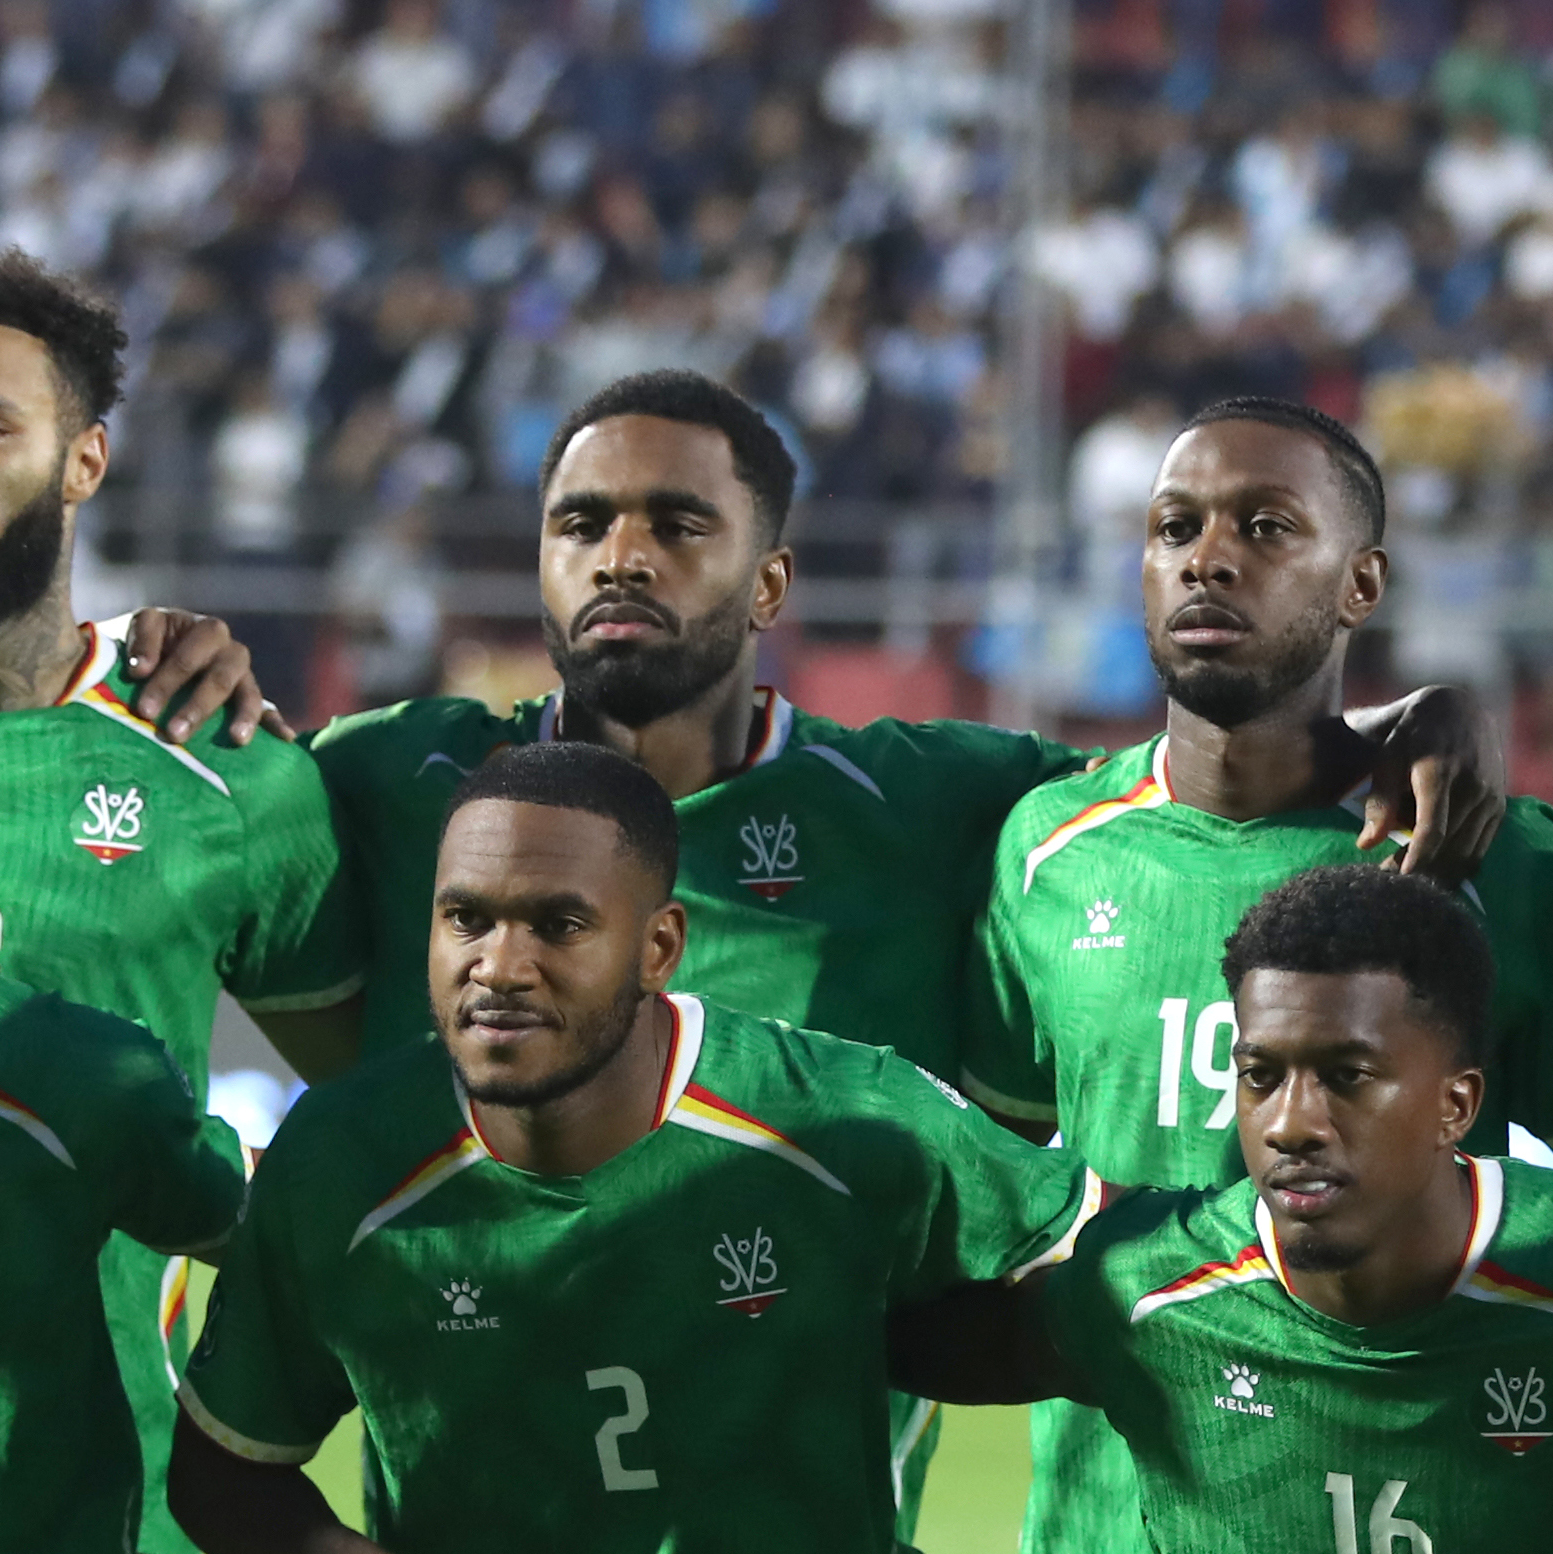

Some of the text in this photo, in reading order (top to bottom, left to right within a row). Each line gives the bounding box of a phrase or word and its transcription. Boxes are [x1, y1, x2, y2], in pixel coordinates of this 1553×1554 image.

[1072, 935, 1125, 949] KELME
[1157, 998, 1238, 1130] 19
[437, 1316, 501, 1331] KELME
[1214, 1394, 1275, 1419] KELME
[585, 1365, 659, 1493] 2
